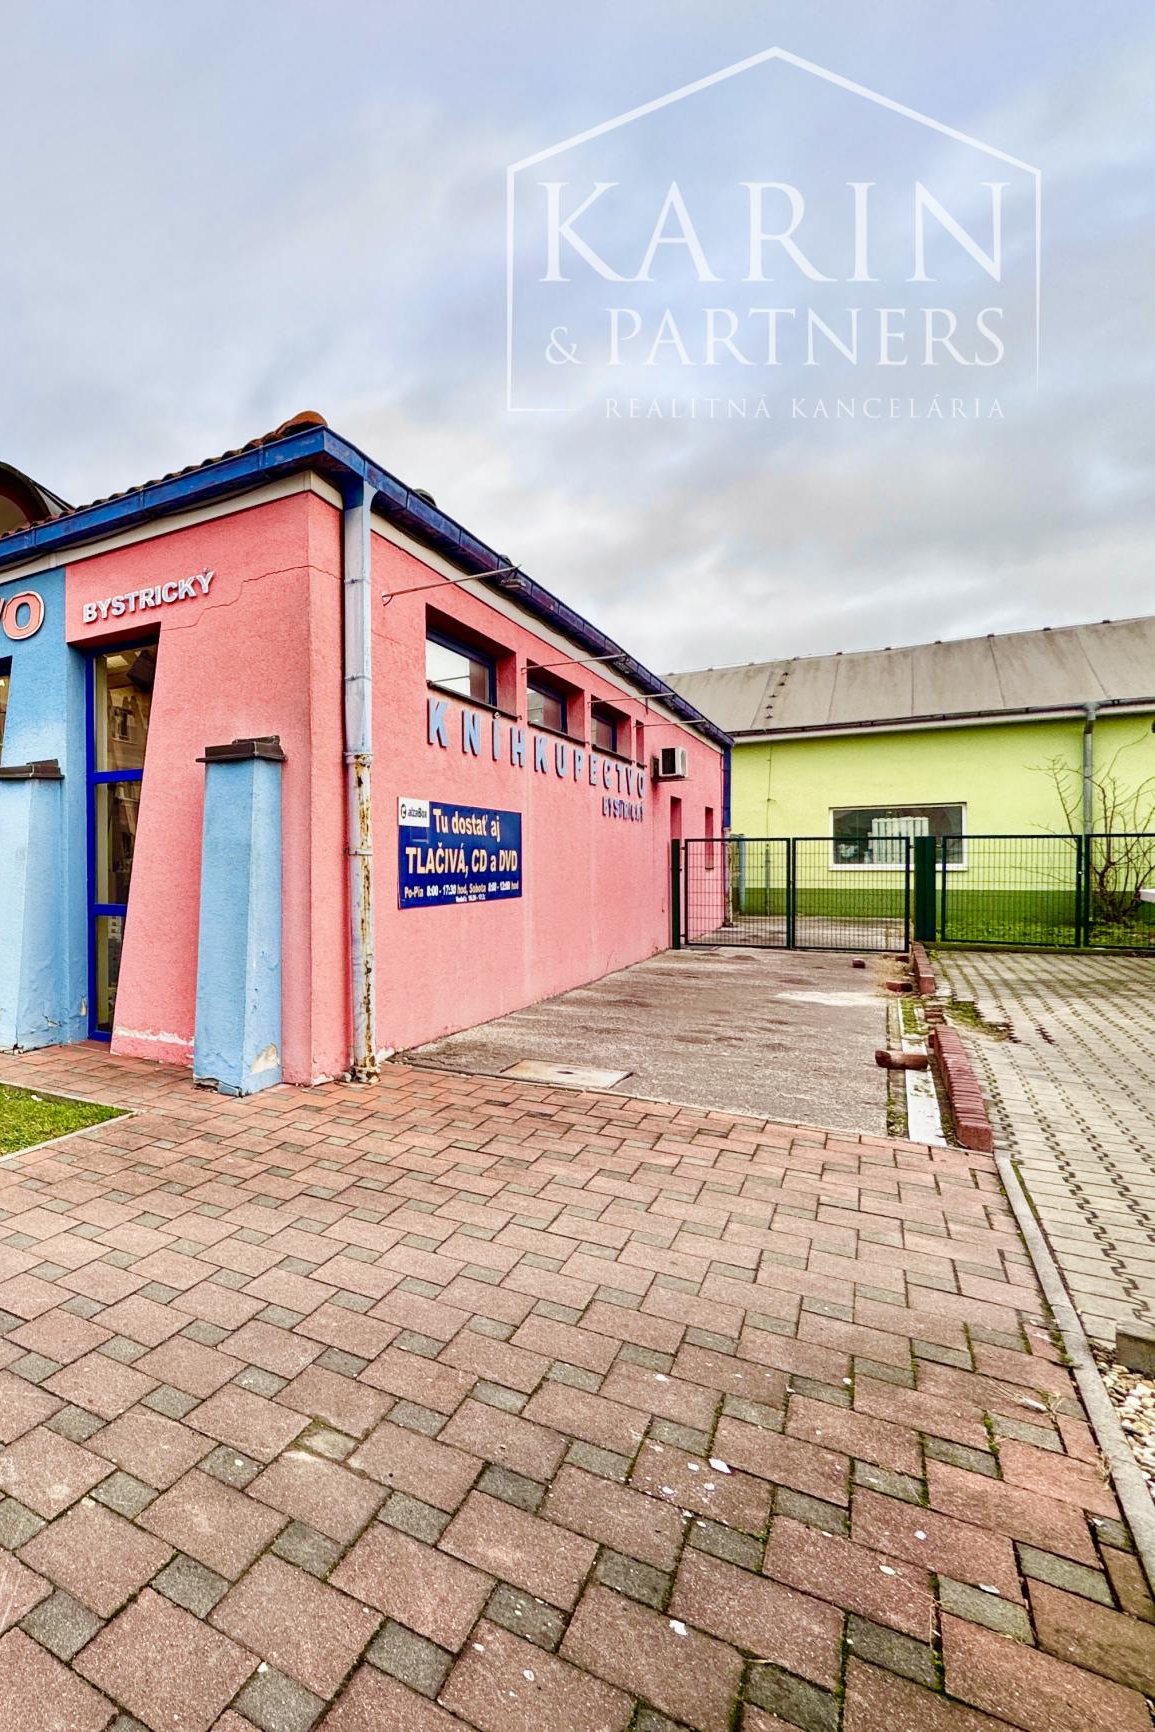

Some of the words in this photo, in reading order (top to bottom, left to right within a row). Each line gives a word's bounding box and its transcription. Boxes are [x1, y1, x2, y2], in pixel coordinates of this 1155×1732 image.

[82, 567, 215, 624] BYSTRICKÝ
[432, 808, 449, 834] Tu
[451, 811, 488, 837] dostať
[490, 815, 501, 843] aj
[405, 841, 469, 879] TLAČIVÁ,
[471, 849, 487, 873] CD
[490, 854, 497, 872] a
[498, 849, 518, 872] DVD
